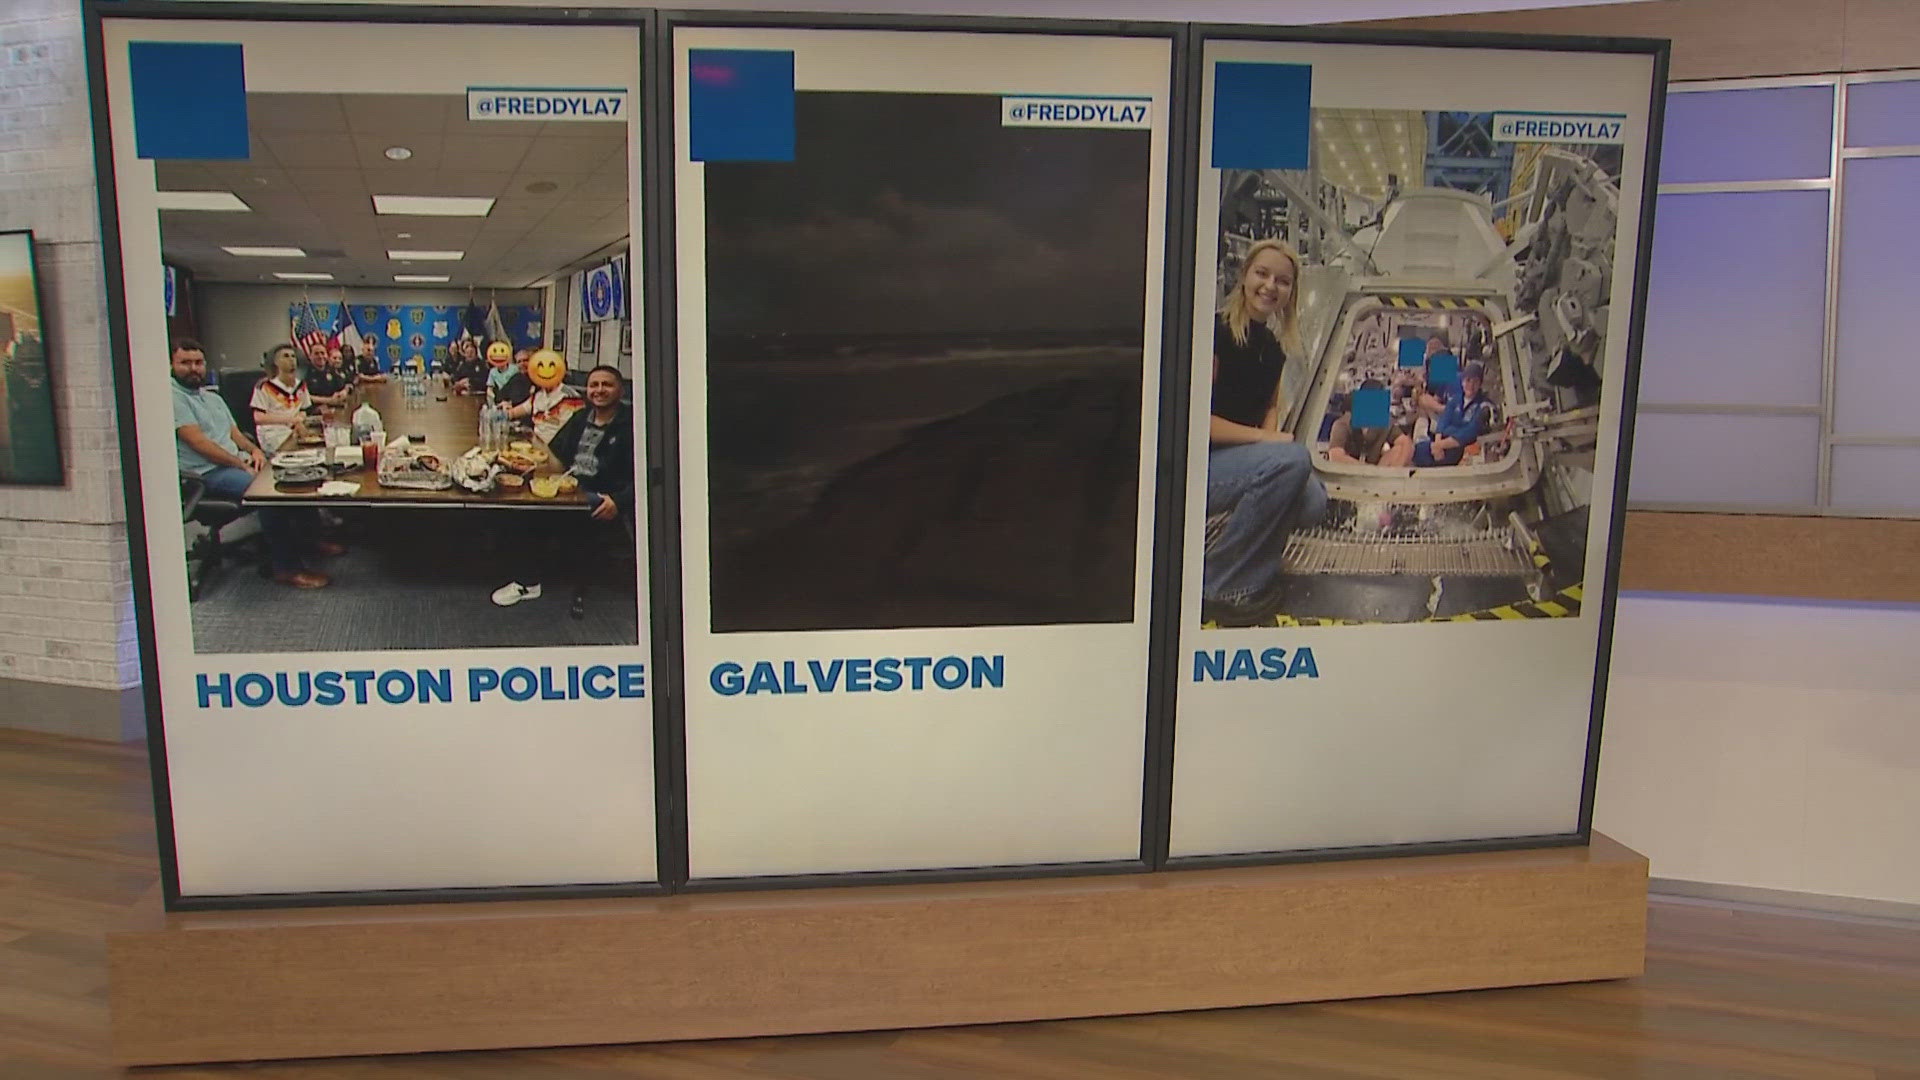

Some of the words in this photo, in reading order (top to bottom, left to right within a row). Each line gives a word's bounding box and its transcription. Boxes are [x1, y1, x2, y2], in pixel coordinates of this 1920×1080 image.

[478, 96, 622, 116] @FREDDYLA7
[1010, 103, 1148, 123] @FREDDYLA7
[1500, 119, 1623, 139] @FREDDYLA7
[709, 655, 1004, 697] GALVESTON
[1193, 647, 1319, 683] NASA
[195, 668, 453, 709] HOUSTON
[467, 664, 646, 703] POLICE
